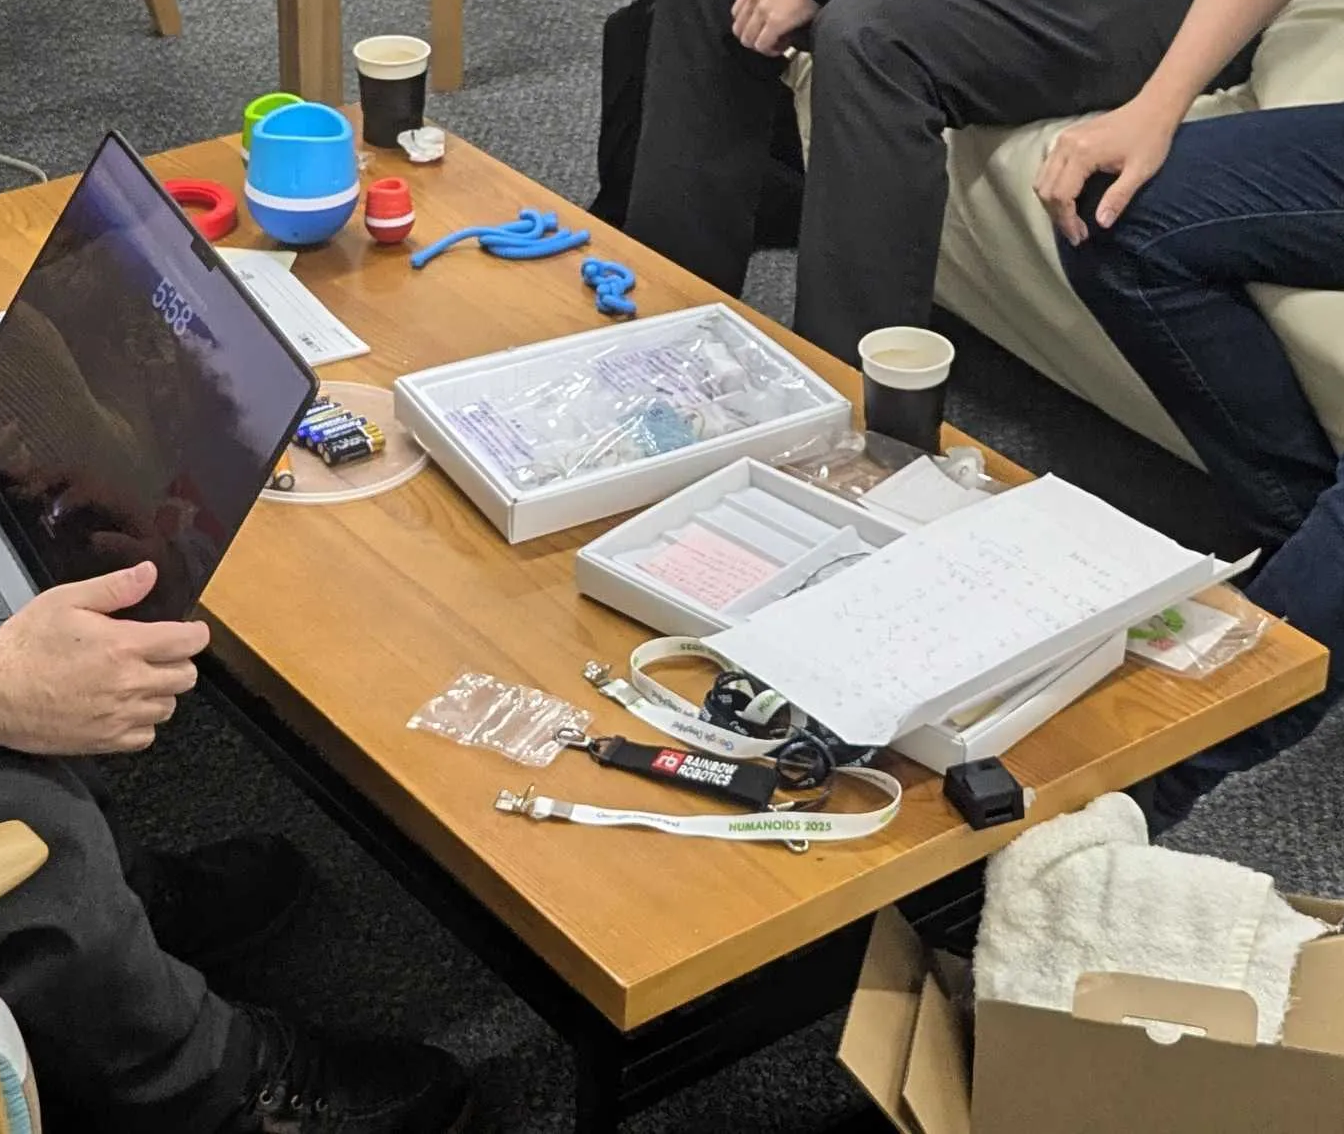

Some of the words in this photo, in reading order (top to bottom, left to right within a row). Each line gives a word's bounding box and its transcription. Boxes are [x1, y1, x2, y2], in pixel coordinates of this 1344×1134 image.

[152, 277, 193, 336] 5:58
[683, 755, 739, 774] RAINBOW
[677, 765, 733, 786] ROBOTICS
[728, 819, 801, 833] HUMANOIDS
[804, 820, 833, 832] 2025
